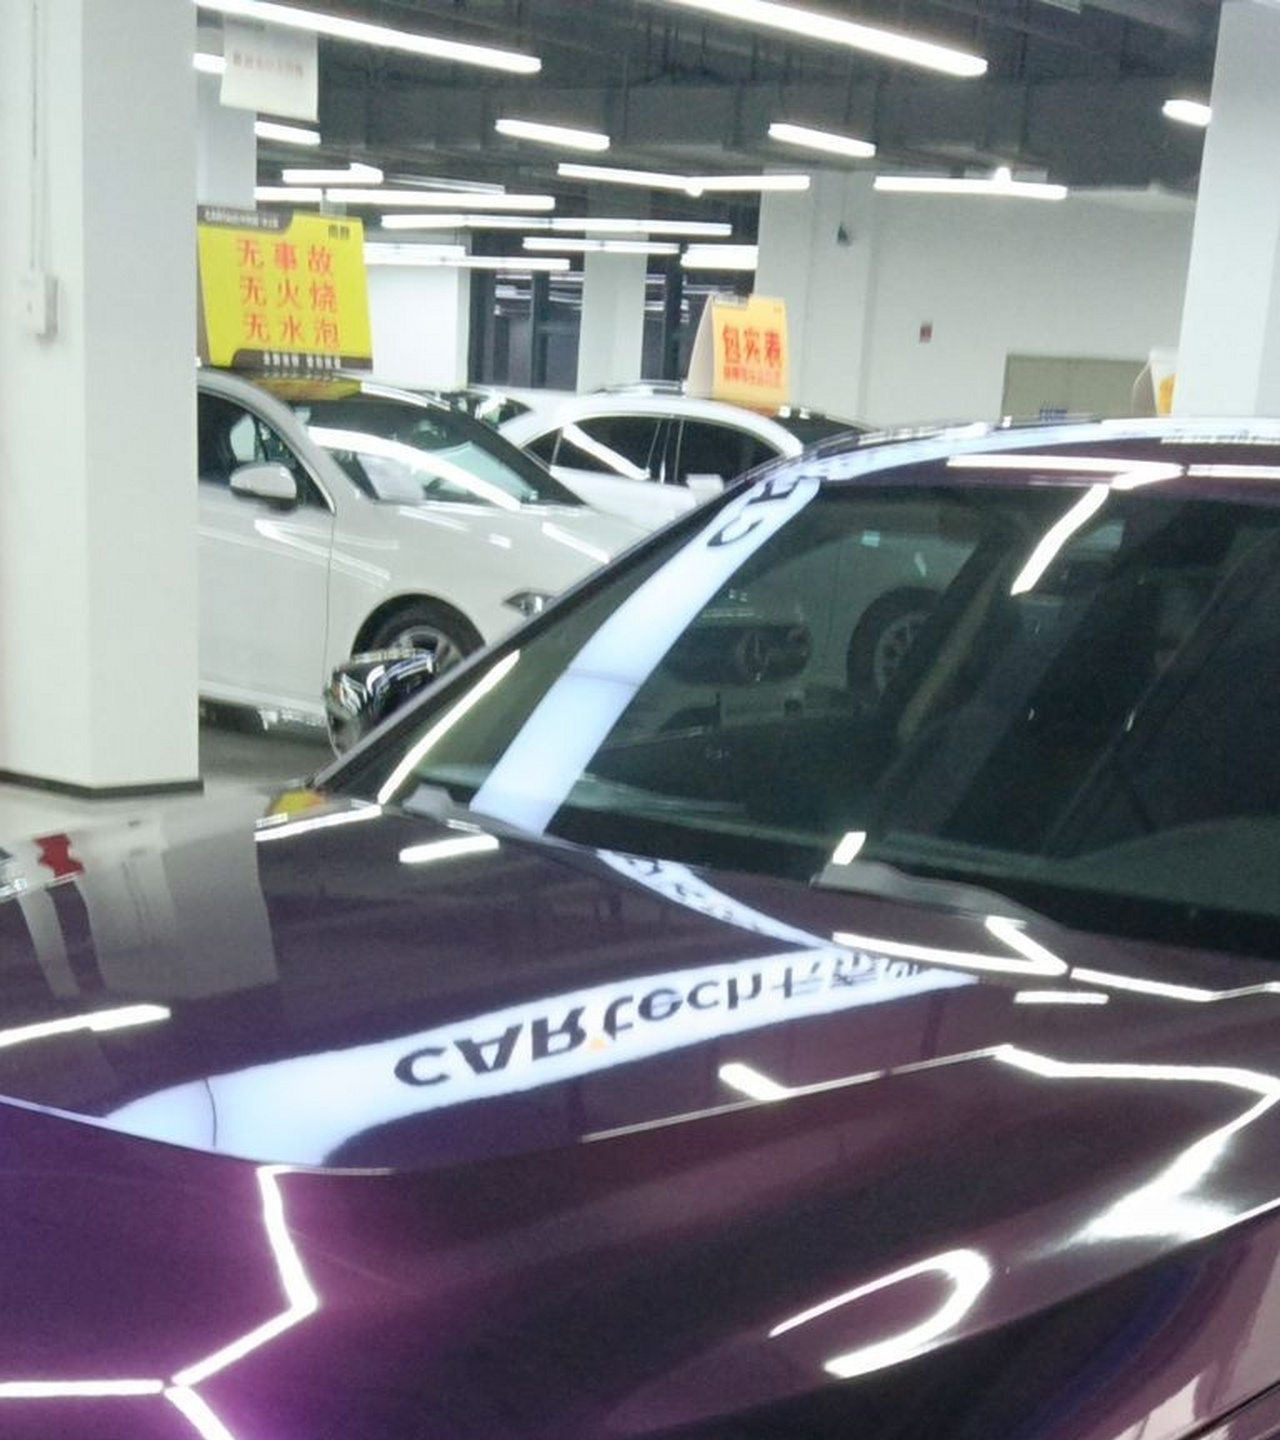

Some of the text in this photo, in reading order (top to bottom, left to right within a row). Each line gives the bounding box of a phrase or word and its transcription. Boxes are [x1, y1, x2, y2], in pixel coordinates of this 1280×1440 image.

[237, 237, 333, 275] 无事故
[240, 275, 338, 313] 无火烧
[244, 312, 340, 351] 无水泡
